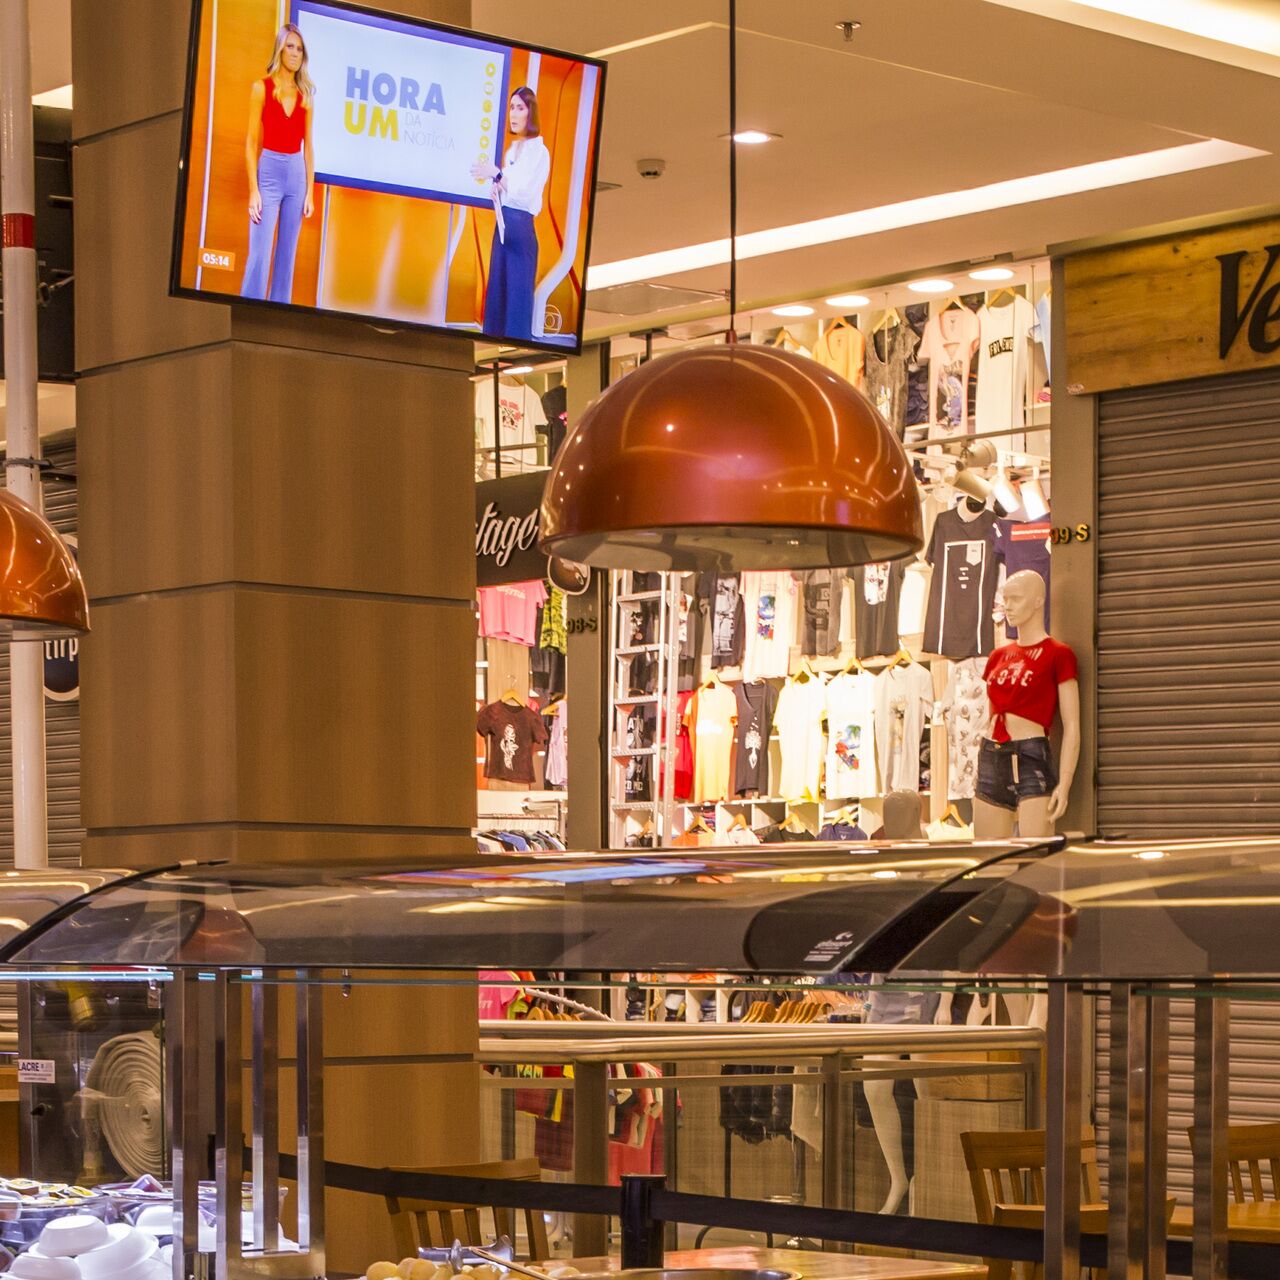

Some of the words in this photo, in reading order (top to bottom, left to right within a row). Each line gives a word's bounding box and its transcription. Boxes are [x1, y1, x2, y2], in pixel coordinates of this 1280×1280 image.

[345, 66, 446, 115] HORA
[344, 101, 399, 141] UM
[404, 111, 422, 128] DA
[202, 252, 230, 267] 05:14
